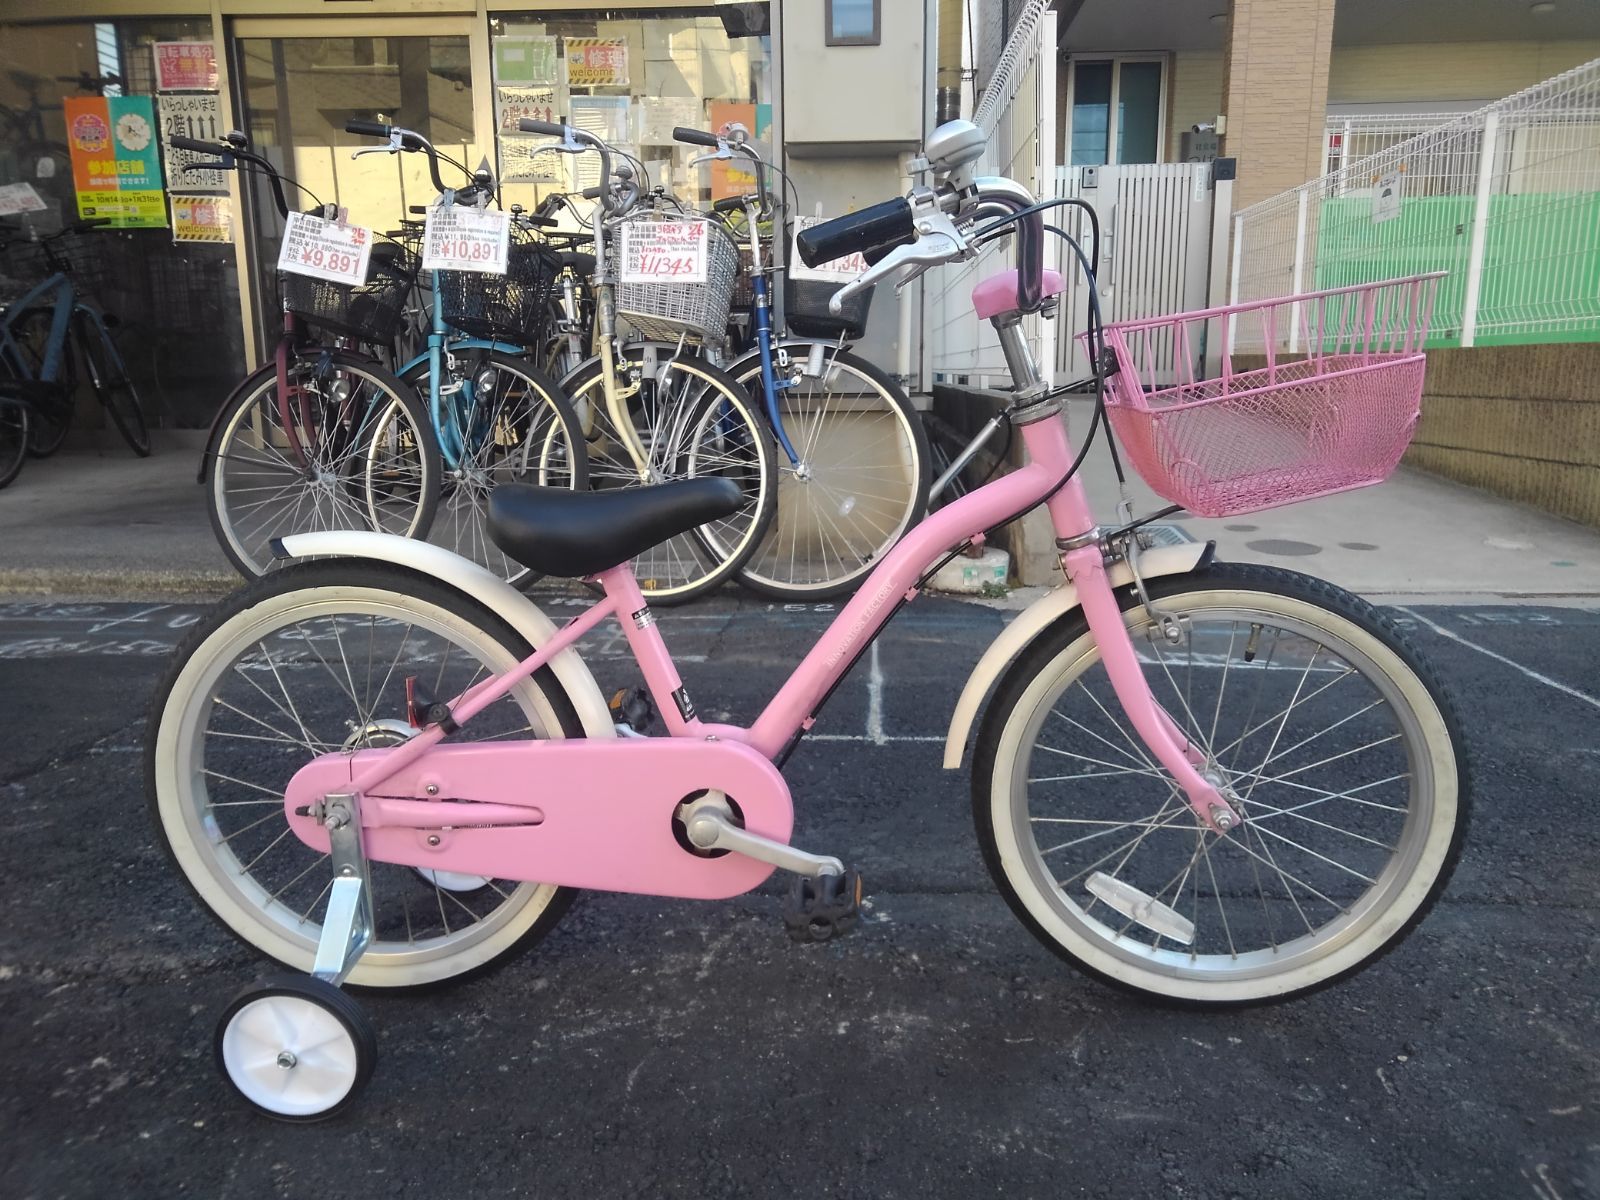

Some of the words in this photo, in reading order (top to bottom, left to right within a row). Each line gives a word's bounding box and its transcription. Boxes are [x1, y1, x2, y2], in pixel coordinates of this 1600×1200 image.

[569, 68, 616, 77] welcome
[161, 98, 216, 112] いらっしゃいませ
[165, 114, 186, 137] 2階
[301, 246, 360, 275] ¥9,891
[441, 239, 499, 261] ¥10,891
[825, 620, 865, 667] INNOVATION
[864, 583, 894, 619] FACTORY
